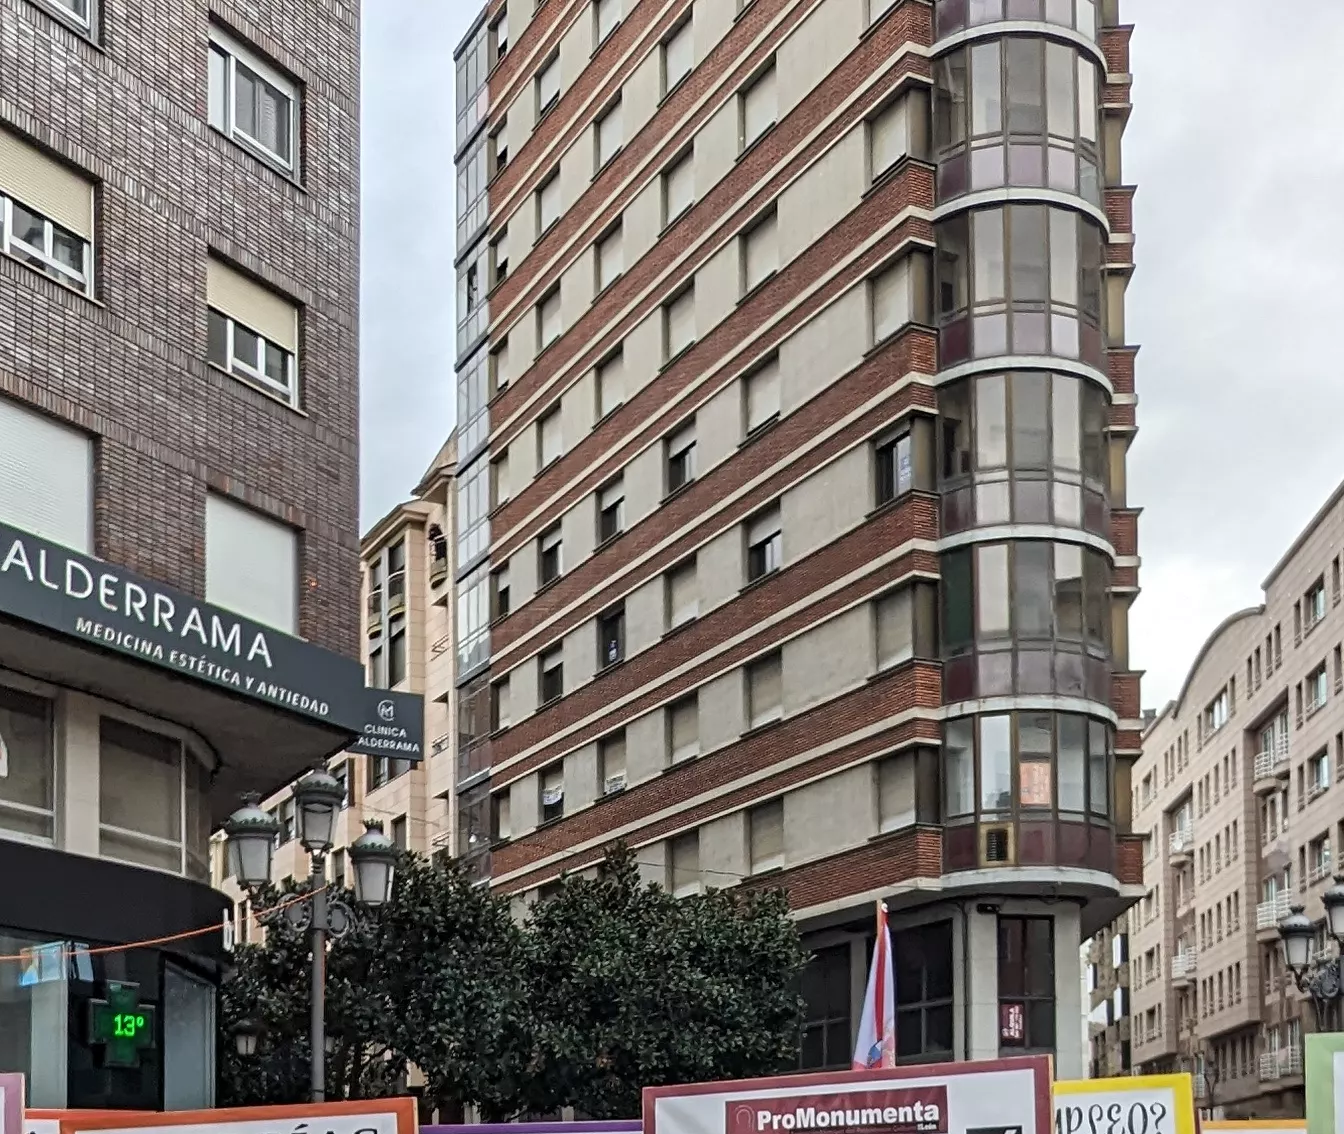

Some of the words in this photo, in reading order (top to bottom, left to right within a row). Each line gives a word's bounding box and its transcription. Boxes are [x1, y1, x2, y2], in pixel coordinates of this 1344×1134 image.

[76, 617, 163, 661] MEDICINA
[169, 650, 241, 687] ESTÉTICA
[246, 674, 256, 692] Y
[257, 681, 330, 718] ANTIEDAD
[363, 724, 408, 741] CLINICA
[357, 736, 421, 754] ALDERRAMA
[757, 1100, 940, 1131] ProMonumenta
